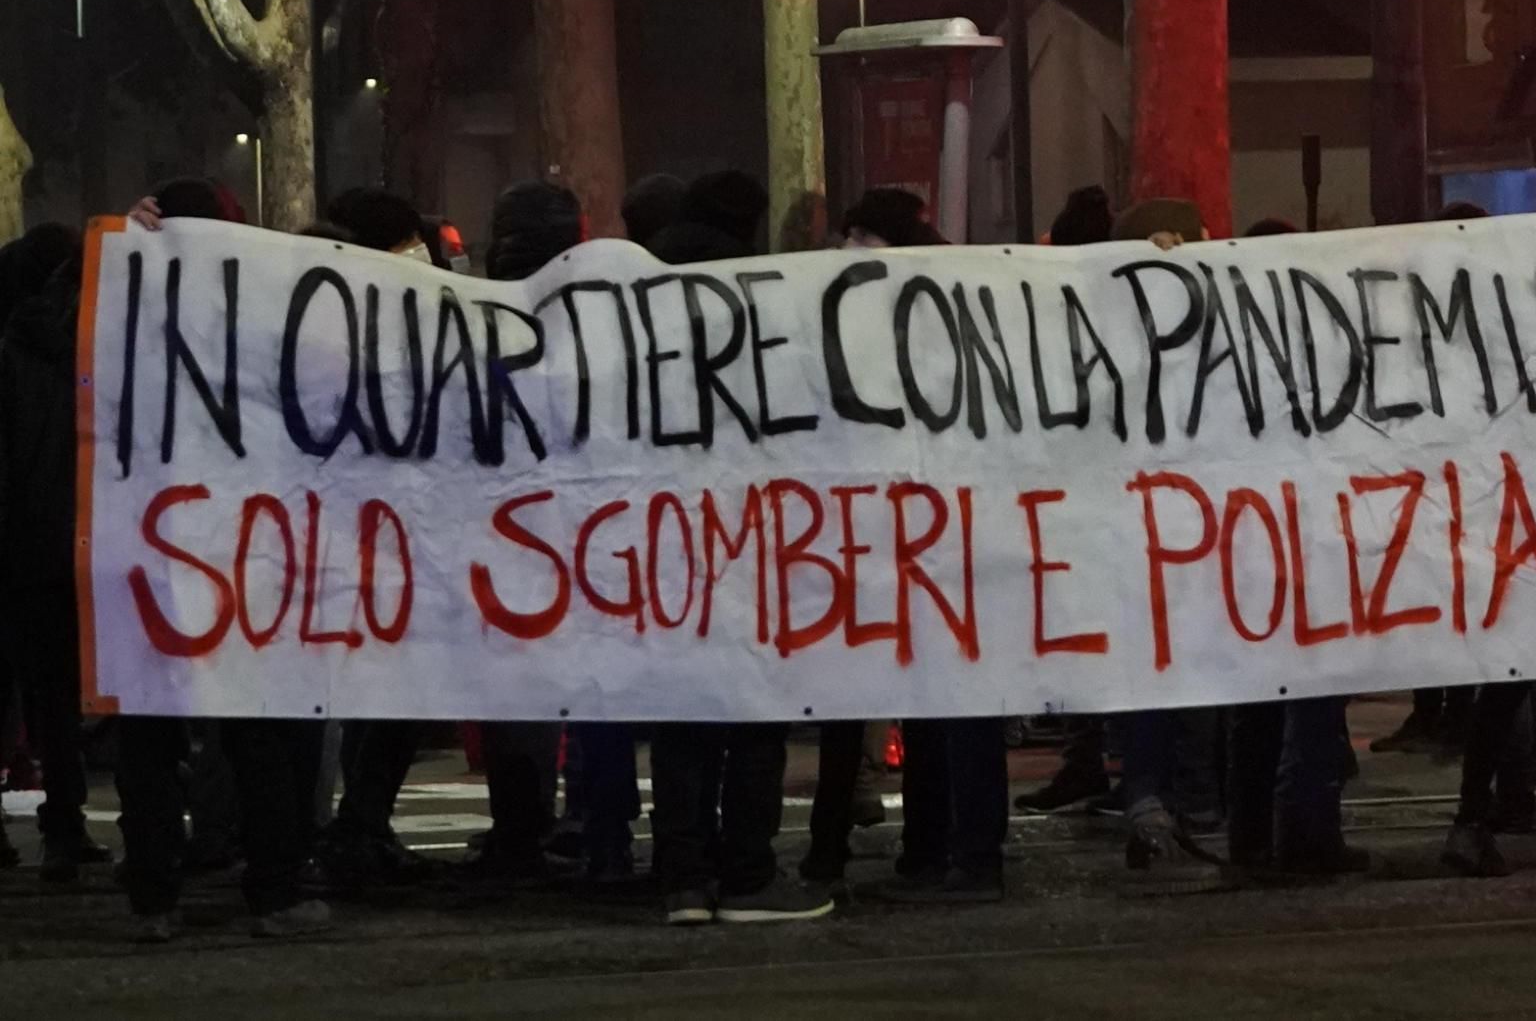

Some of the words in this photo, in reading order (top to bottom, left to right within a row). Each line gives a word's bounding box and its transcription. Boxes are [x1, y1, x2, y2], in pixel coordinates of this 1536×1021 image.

[116, 250, 247, 480] IN
[279, 264, 820, 466] QUARTIERE
[127, 481, 414, 659] SOLO
[469, 477, 979, 668] SGOMBERI
[1016, 489, 1110, 656] E
